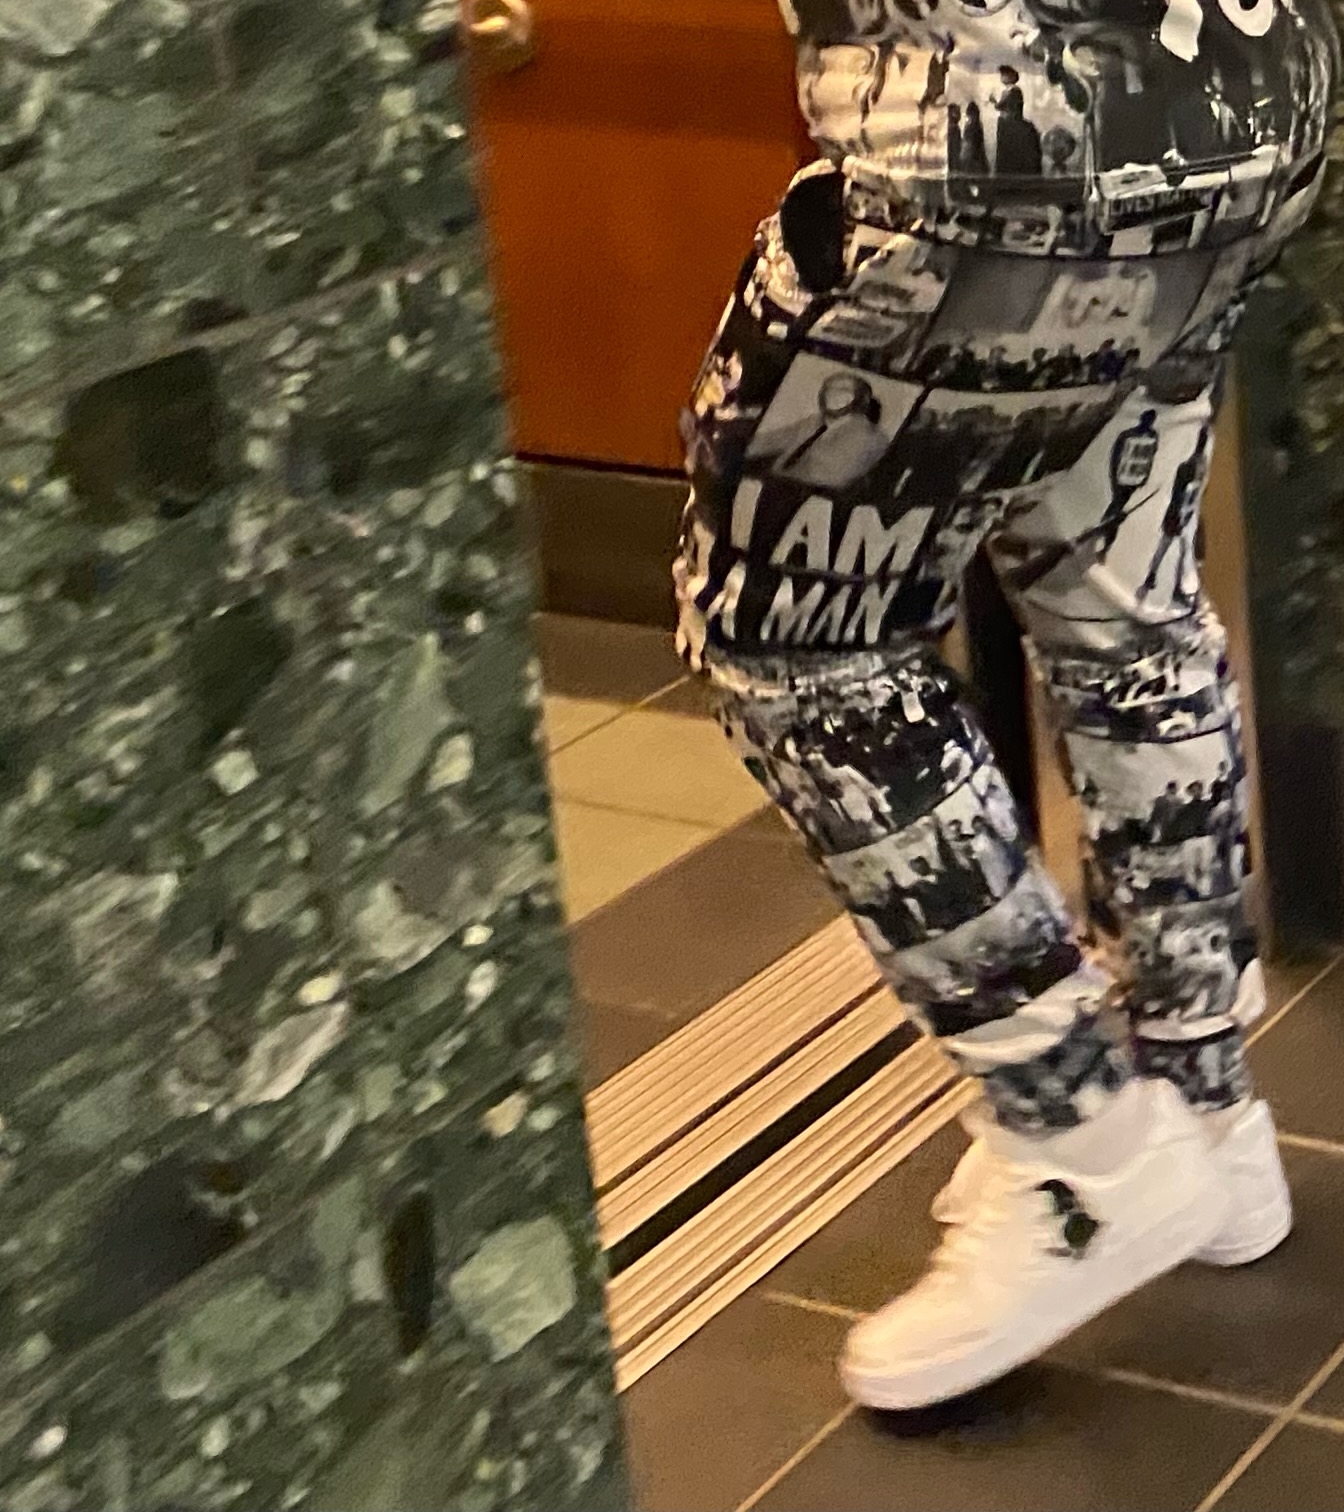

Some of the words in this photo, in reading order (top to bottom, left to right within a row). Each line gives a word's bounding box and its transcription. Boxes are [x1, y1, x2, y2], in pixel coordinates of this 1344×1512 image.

[730, 477, 763, 551] I
[769, 494, 936, 576] AM
[759, 573, 900, 645] MAN
